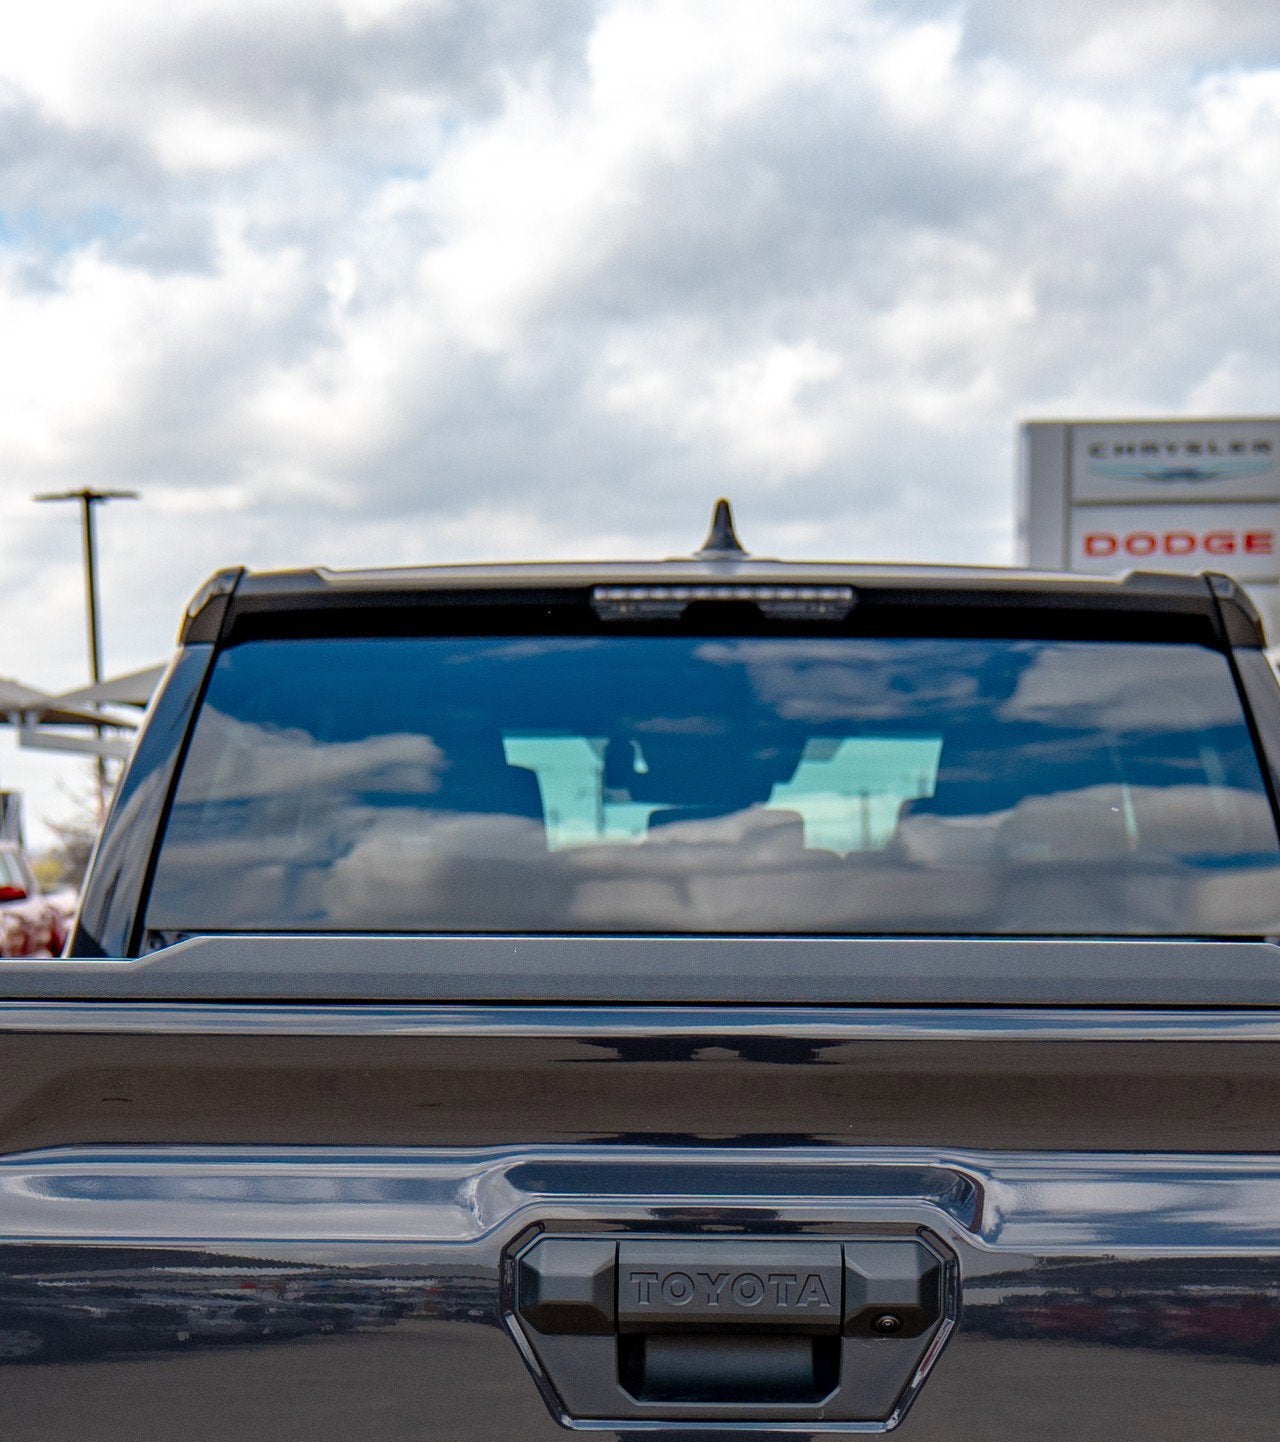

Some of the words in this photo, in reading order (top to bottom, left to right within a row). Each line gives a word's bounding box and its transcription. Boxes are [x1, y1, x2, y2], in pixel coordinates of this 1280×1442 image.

[1088, 439, 1273, 460] CHRYSLER
[1083, 529, 1275, 557] DODGE
[629, 1271, 832, 1308] TOYOTA
